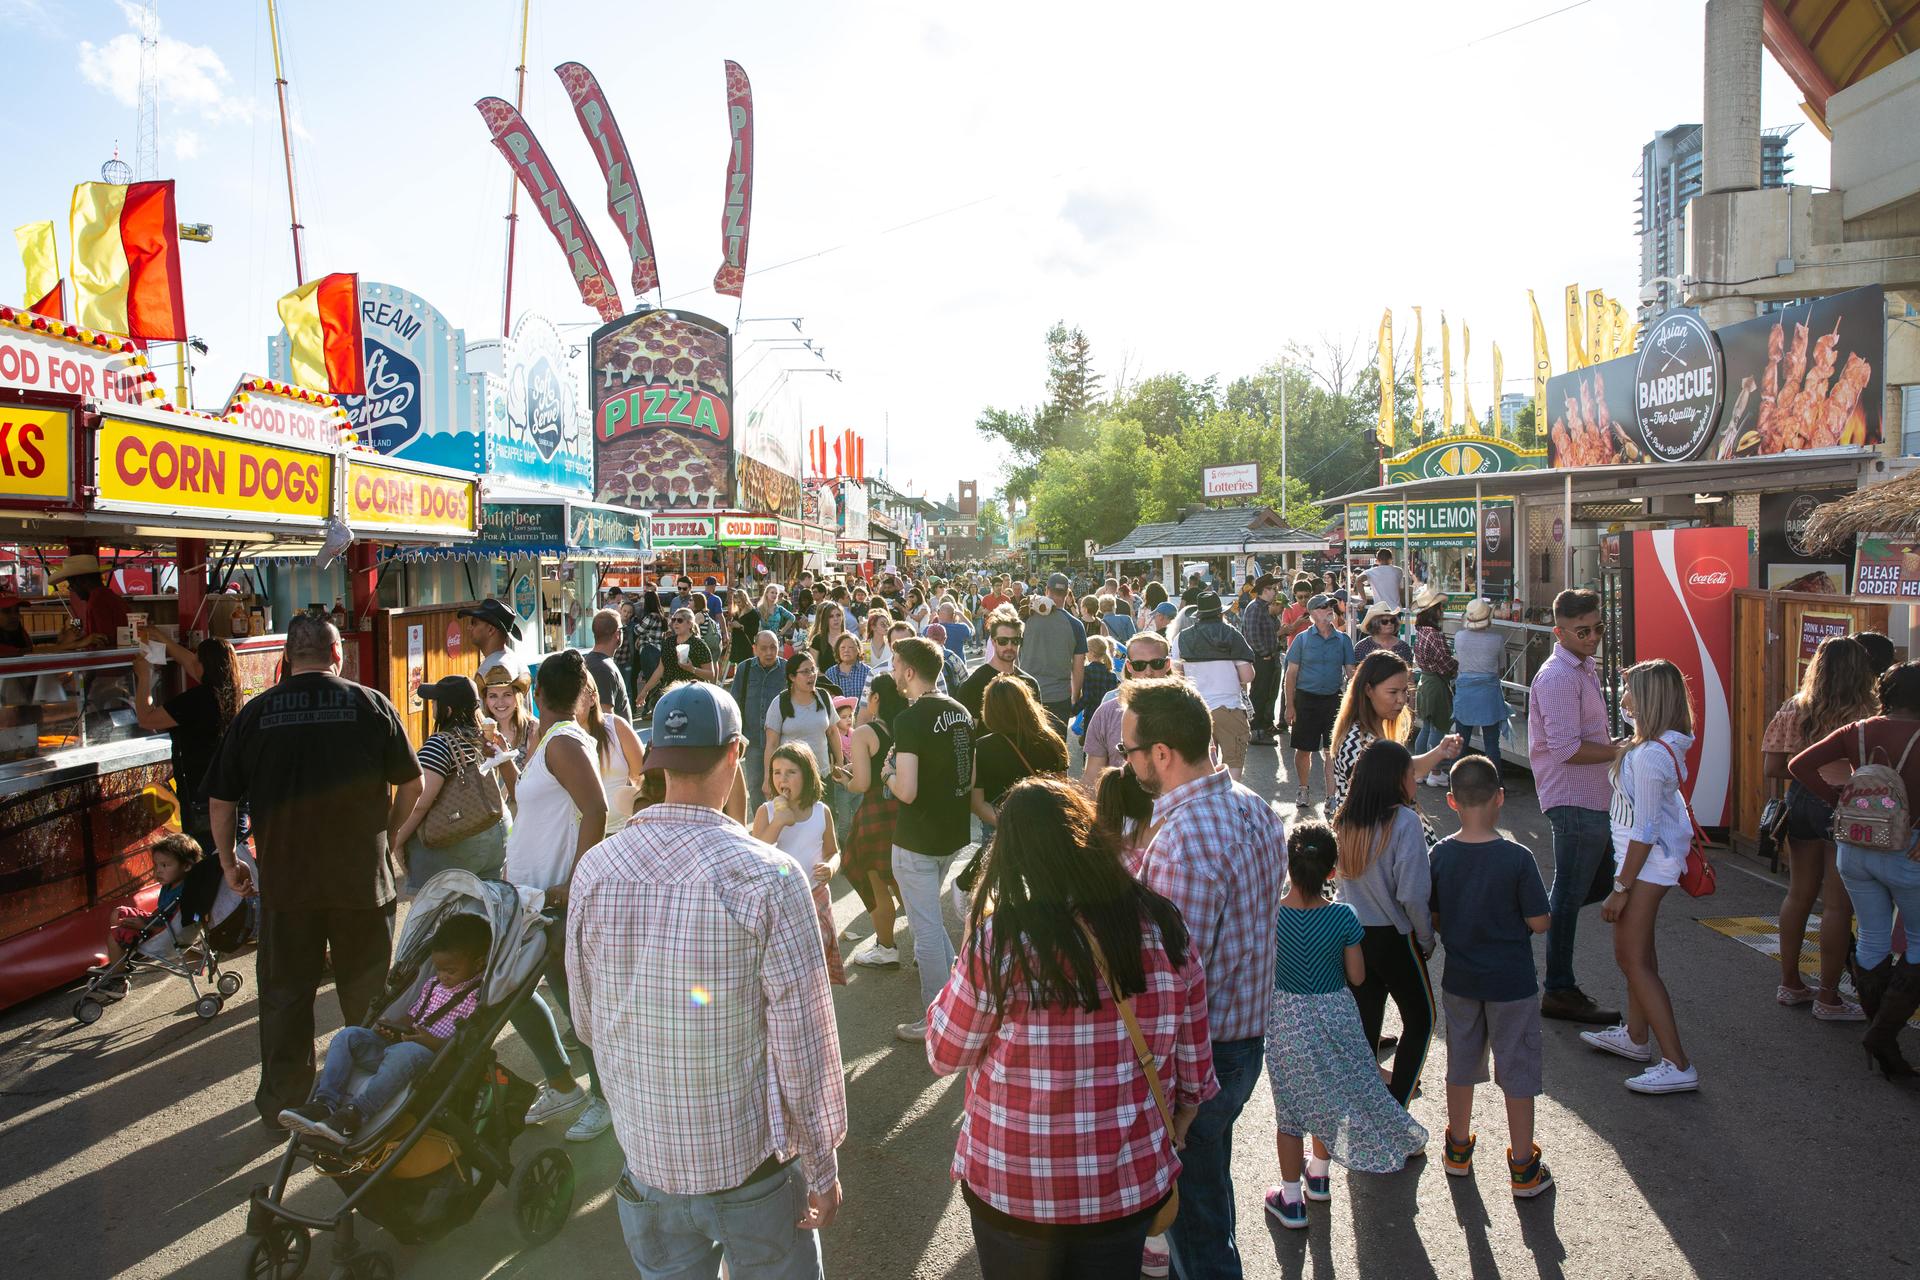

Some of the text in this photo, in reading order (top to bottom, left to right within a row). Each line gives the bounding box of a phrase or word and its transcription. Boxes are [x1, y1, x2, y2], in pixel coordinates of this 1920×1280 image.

[580, 99, 649, 261] PIZZA
[725, 105, 747, 268] PIZZA
[504, 132, 599, 282] PIZZA
[362, 301, 421, 341] REAM
[1657, 322, 1688, 346] Asian
[48, 355, 95, 397] FOR
[103, 369, 142, 406] FUN
[532, 368, 559, 408] Soft
[1639, 366, 1713, 409] BARBECUE
[244, 404, 285, 434] FOOD
[289, 413, 315, 440] FOR
[347, 394, 406, 426] erve
[532, 408, 559, 434] Serve
[605, 388, 720, 438] PIZZA
[1653, 406, 1697, 426] Top Quality
[1667, 442, 1691, 455] Chicken
[115, 436, 319, 504] CORN DOGS
[355, 475, 466, 520] CORN DOGS
[1208, 479, 1253, 493] Lotteries
[481, 507, 541, 528] Butterbeer
[669, 522, 706, 536] PIZZA
[727, 522, 751, 535] COLD
[1350, 518, 1369, 531] LEMONAD
[1381, 508, 1426, 529] FRESH
[1786, 520, 1805, 532] BARB
[483, 532, 559, 541] FOR A LIMITED TIME
[1688, 572, 1729, 585] Coca-Cola
[1860, 566, 1900, 581] PLEASE
[1858, 580, 1920, 596] ORDER HE
[1803, 622, 1846, 637] DRINK A FRUIT
[263, 688, 358, 715] THUG LIFE
